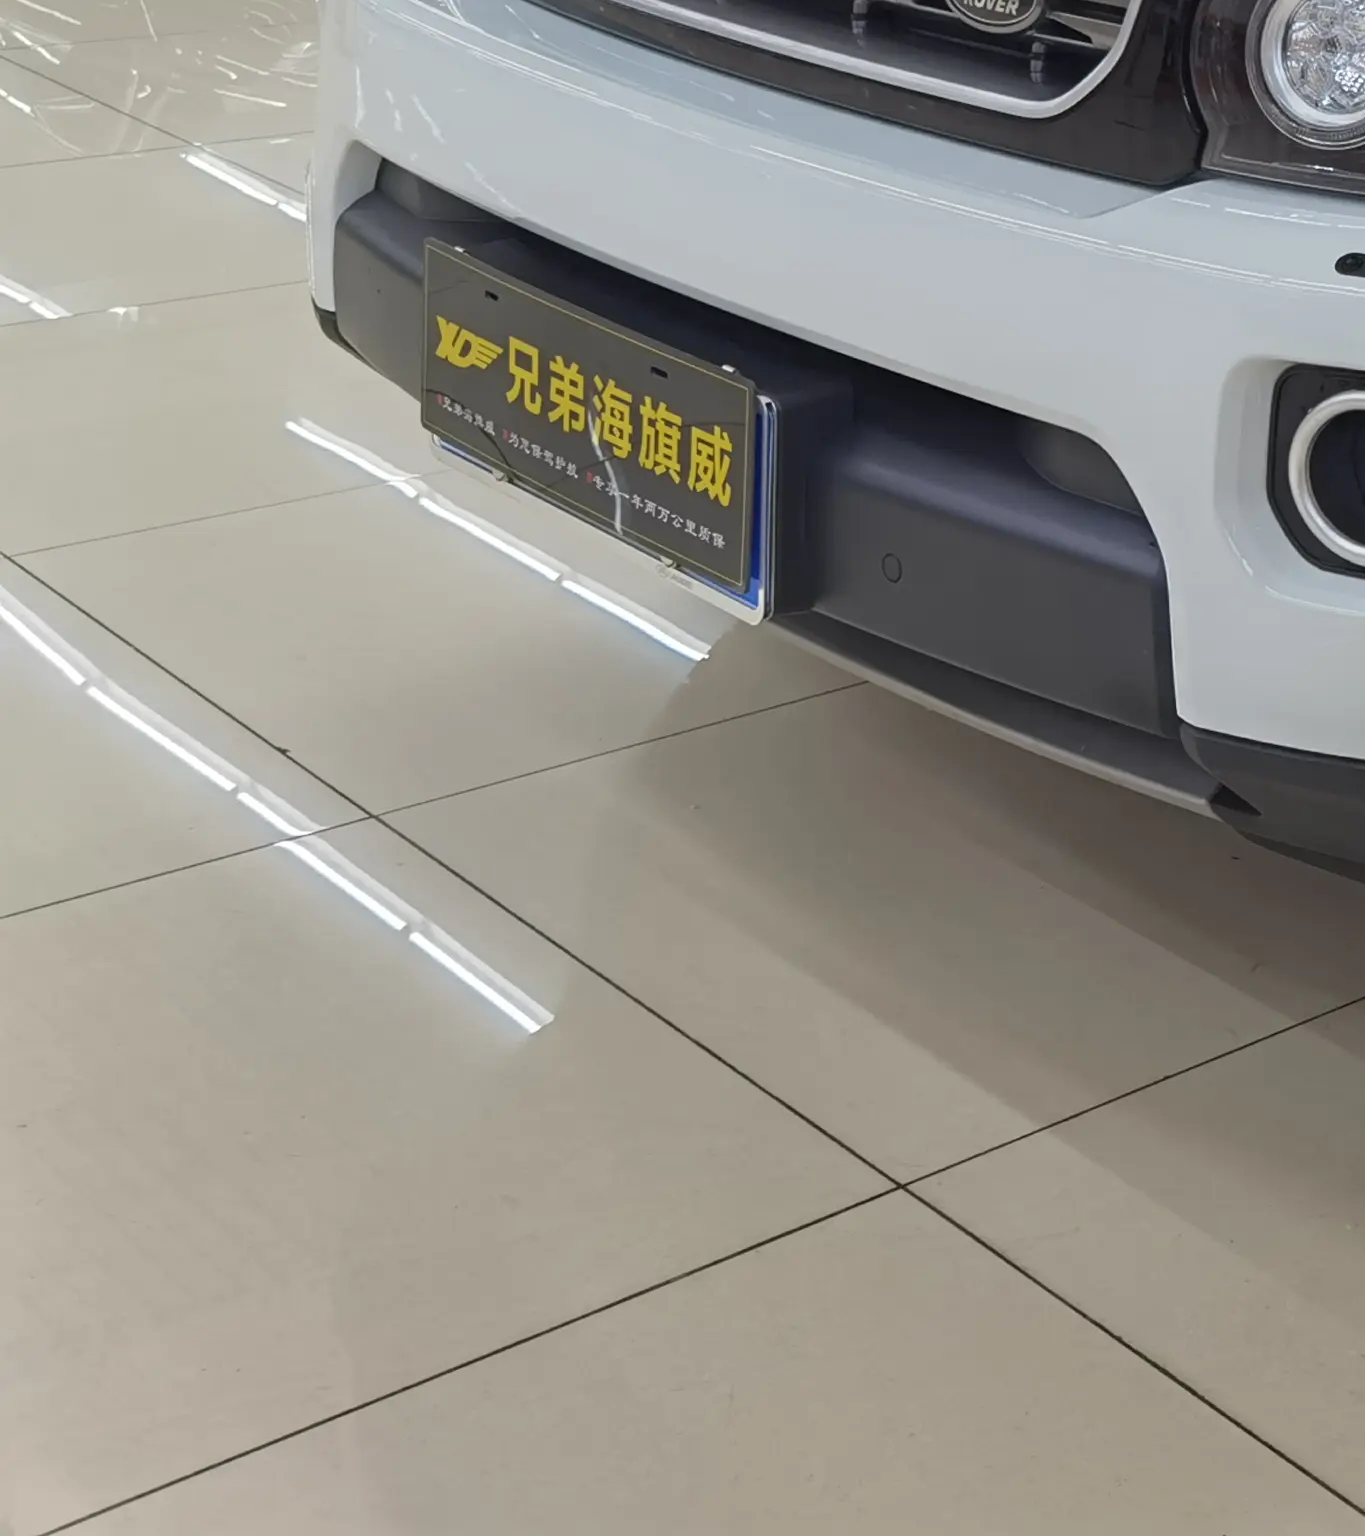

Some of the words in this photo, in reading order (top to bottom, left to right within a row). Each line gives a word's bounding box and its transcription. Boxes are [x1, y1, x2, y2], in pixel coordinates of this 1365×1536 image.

[506, 335, 733, 508] 兄弟海旗威
